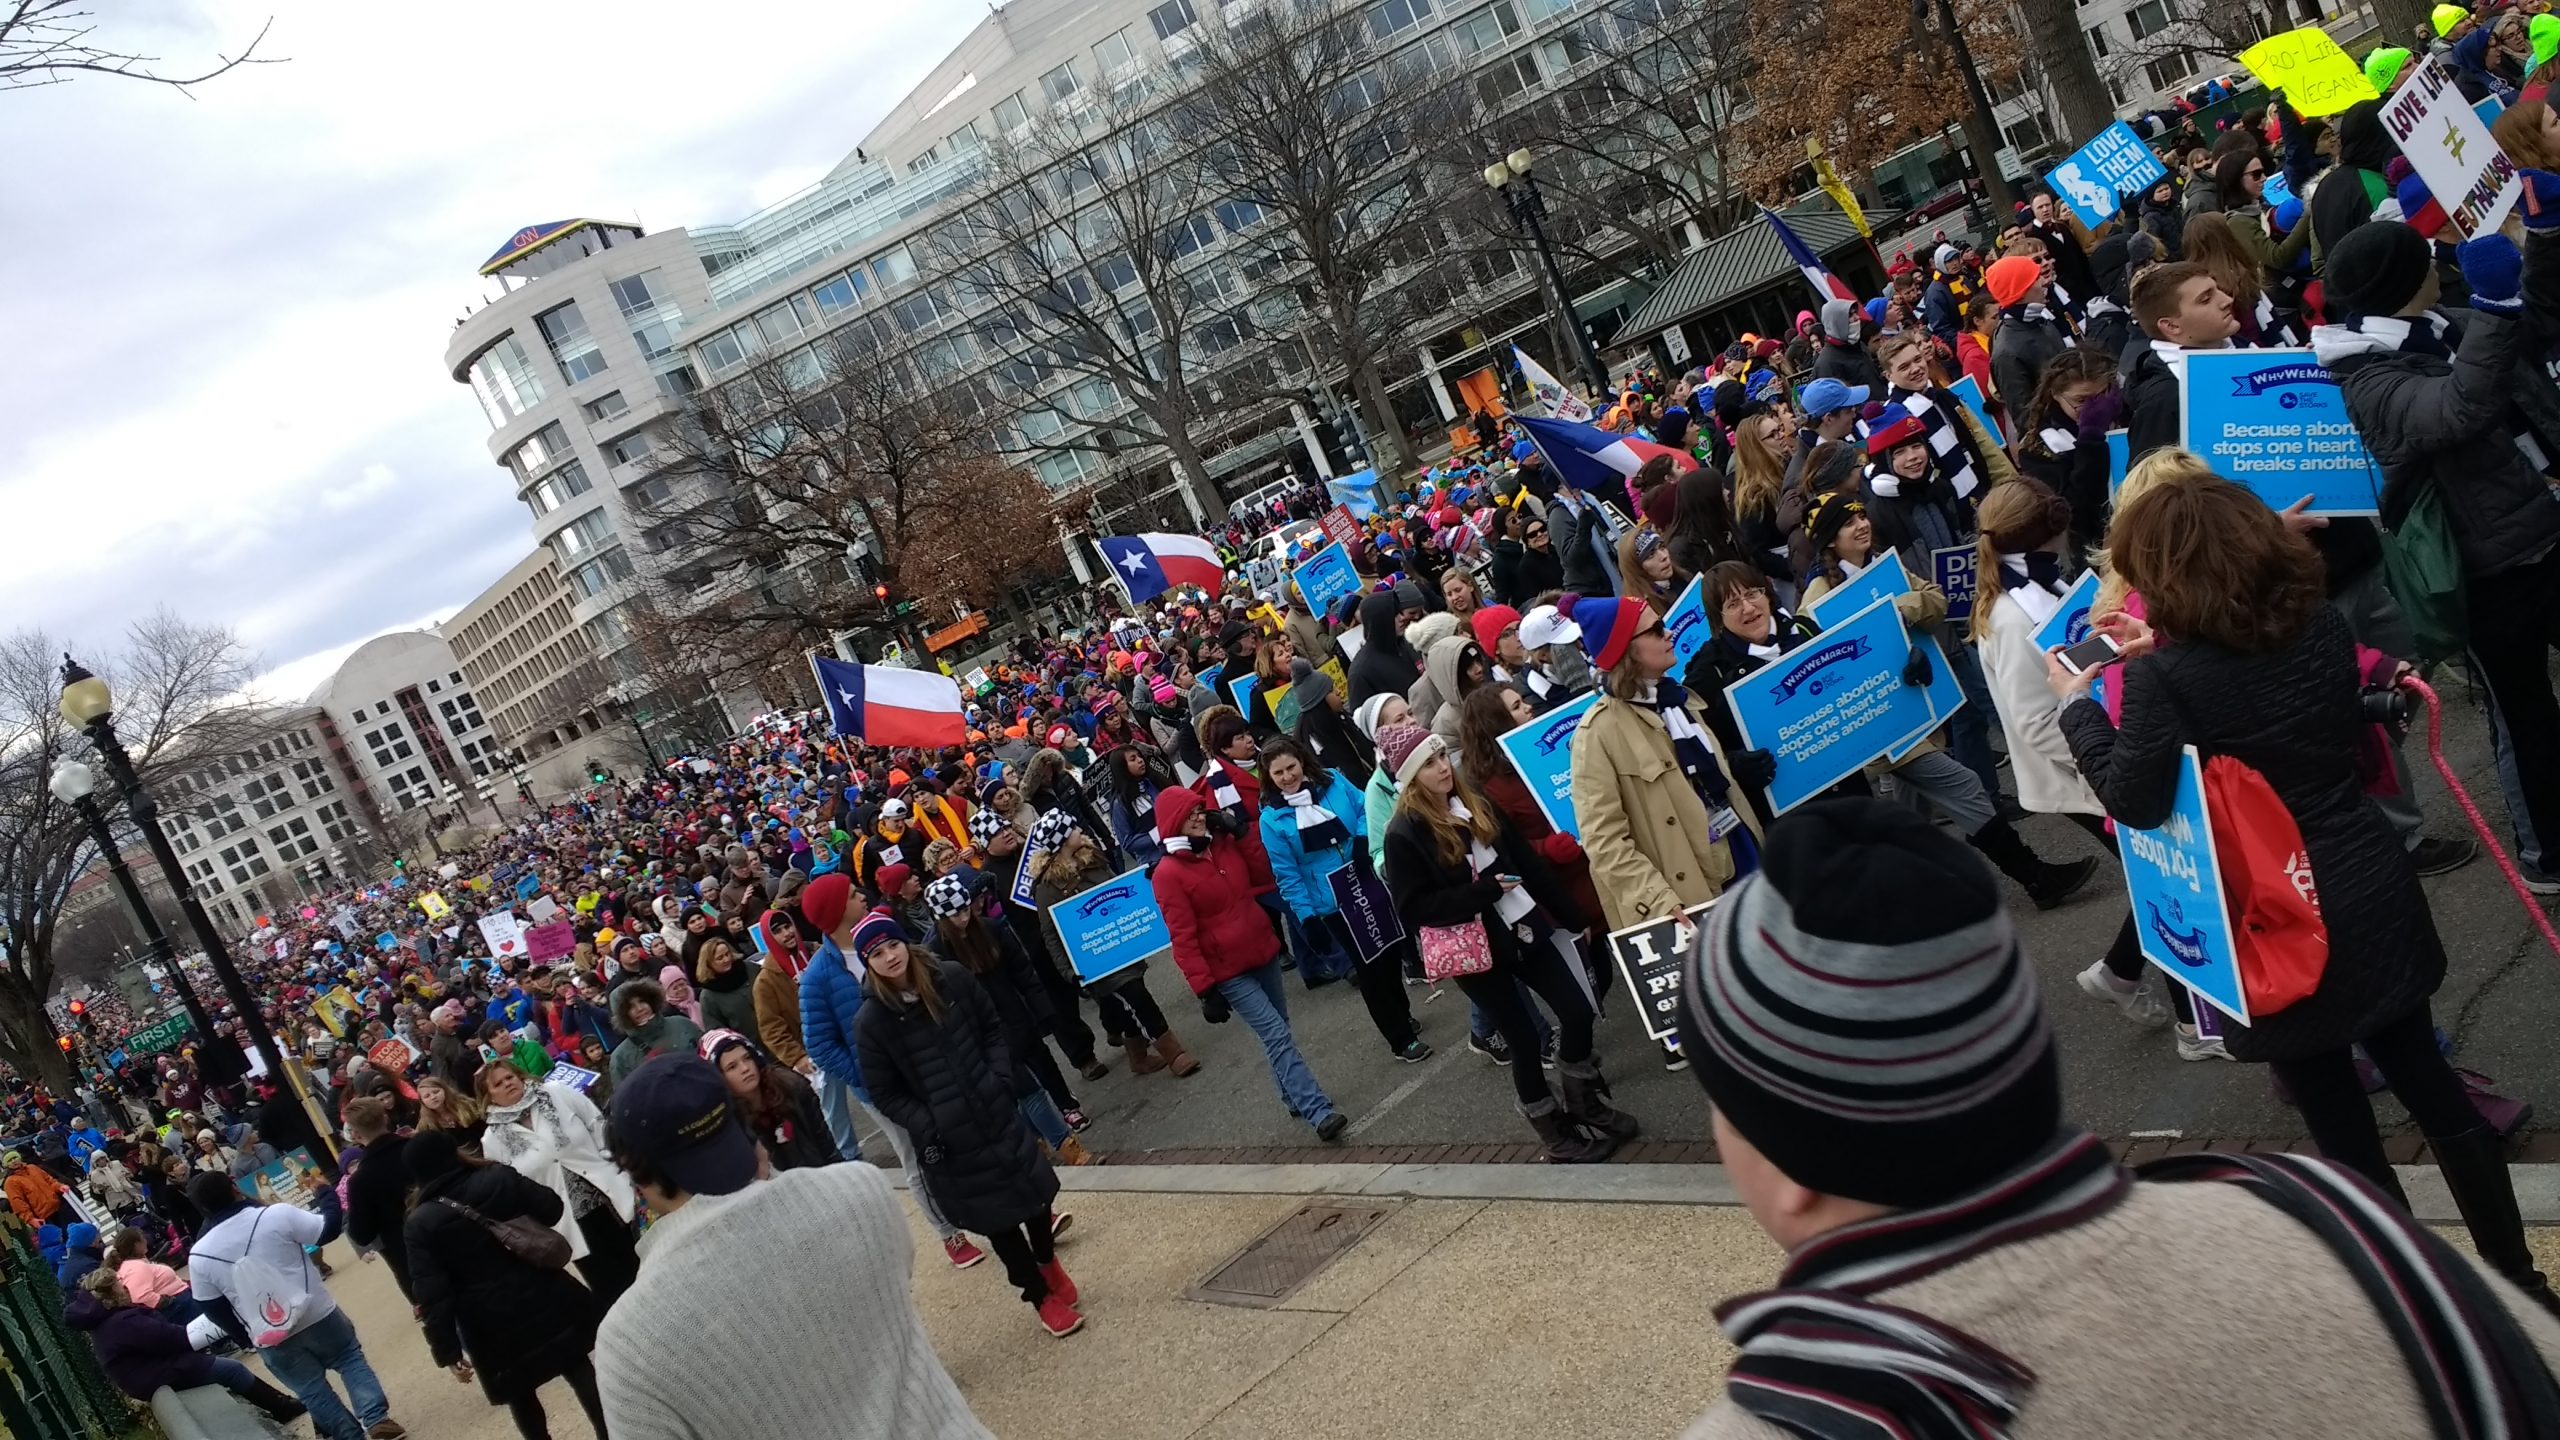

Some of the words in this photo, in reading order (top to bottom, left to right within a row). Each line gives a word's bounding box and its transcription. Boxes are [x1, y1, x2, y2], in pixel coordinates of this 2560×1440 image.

[2243, 33, 2342, 72] PRO-LIFE
[2283, 72, 2377, 104] VEGANS
[2386, 89, 2428, 143] LOVE
[2417, 57, 2450, 102] LIFE
[2083, 126, 2129, 166] LOVE
[2096, 142, 2146, 183] THEM
[514, 226, 539, 247] CNN
[2223, 422, 2301, 437] Because
[2305, 421, 2359, 436] abort
[2212, 440, 2263, 457] stops
[2266, 442, 2303, 454] one
[2307, 438, 2356, 453] heart
[2233, 456, 2296, 472] breaks
[1323, 508, 1345, 527] SOCIAL
[1329, 515, 1351, 537] JUSTICE
[1946, 551, 1977, 573] DE
[1311, 581, 1325, 594] For
[1324, 567, 1345, 585] those
[1315, 588, 1331, 602] who
[1947, 573, 1976, 591] PL
[1776, 710, 1813, 758] stops
[1814, 715, 1840, 736] one
[1840, 693, 1875, 720] heart
[1876, 676, 1902, 699] and
[1777, 702, 1834, 740] Because
[1836, 669, 1890, 708] abortion
[1795, 731, 1840, 763] breaks
[1841, 700, 1893, 736] another.
[2129, 827, 2171, 878] those
[2171, 848, 2201, 893] For
[1346, 863, 1385, 949] #IStand4Life
[1081, 921, 1116, 942] Because
[1116, 905, 1150, 927] abortion
[1081, 936, 1104, 952] stops
[1103, 929, 1120, 941] one
[1119, 918, 1141, 933] heart
[1141, 910, 1158, 924] and
[1091, 938, 1121, 956] breaks
[1120, 924, 1153, 943] another.
[1628, 932, 1661, 966] I
[1646, 970, 1682, 995] PR
[130, 1020, 172, 1048] FIRST
[151, 1035, 176, 1052] UNIT
[371, 1041, 394, 1064] STOP
